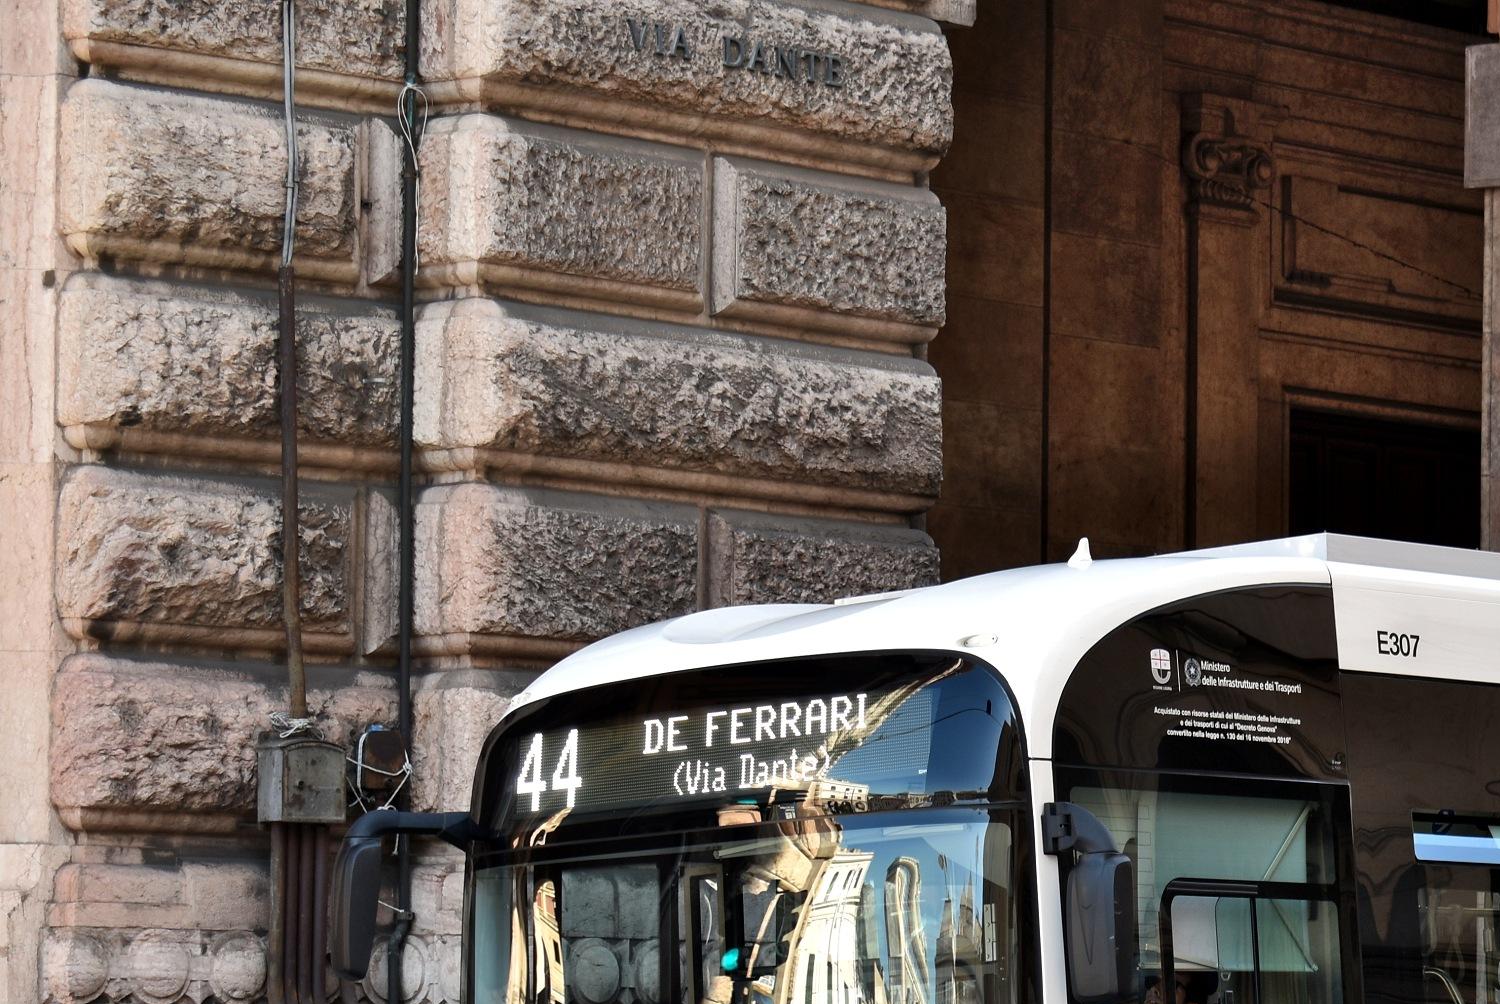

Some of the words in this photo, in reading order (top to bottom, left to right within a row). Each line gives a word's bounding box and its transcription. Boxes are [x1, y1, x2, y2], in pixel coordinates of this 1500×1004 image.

[627, 17, 692, 61] VIA
[723, 35, 846, 88] DANTE
[1376, 630, 1421, 658] E307
[1200, 660, 1231, 673] Ministero
[1201, 675, 1217, 687] delle
[1217, 676, 1259, 690] Infrastrutture
[1265, 680, 1274, 691] dei
[1275, 681, 1302, 695] Trasporti
[642, 715, 690, 755] DE
[705, 693, 869, 748] FERRARI
[516, 728, 583, 812] 44
[672, 760, 727, 796] (Via
